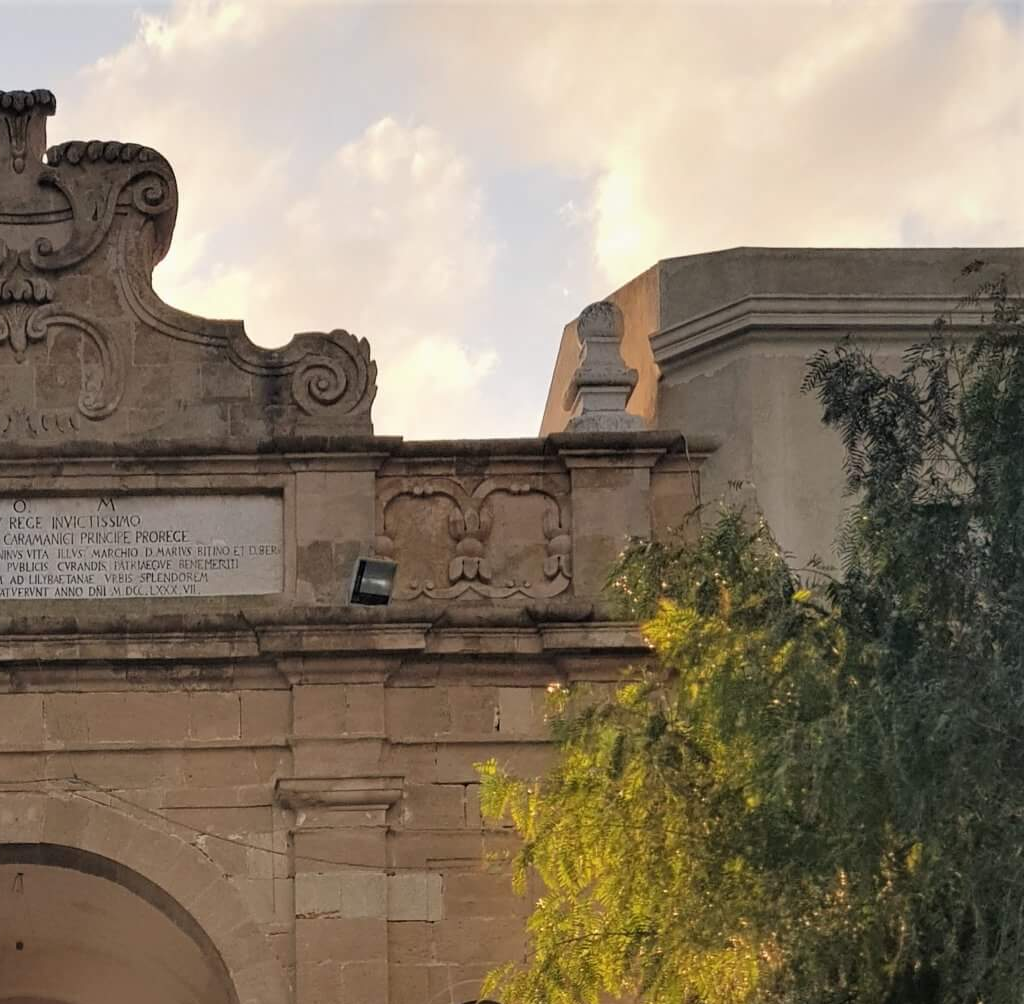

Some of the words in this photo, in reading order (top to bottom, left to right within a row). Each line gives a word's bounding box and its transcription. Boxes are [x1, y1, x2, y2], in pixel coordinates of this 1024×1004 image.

[9, 516, 42, 530] REGE
[52, 515, 142, 530] INVICTISSIMO
[80, 532, 132, 544] PRINCIPE
[136, 530, 188, 543] PROREGE
[26, 549, 48, 560] VITA
[54, 586, 84, 597] ANNO
